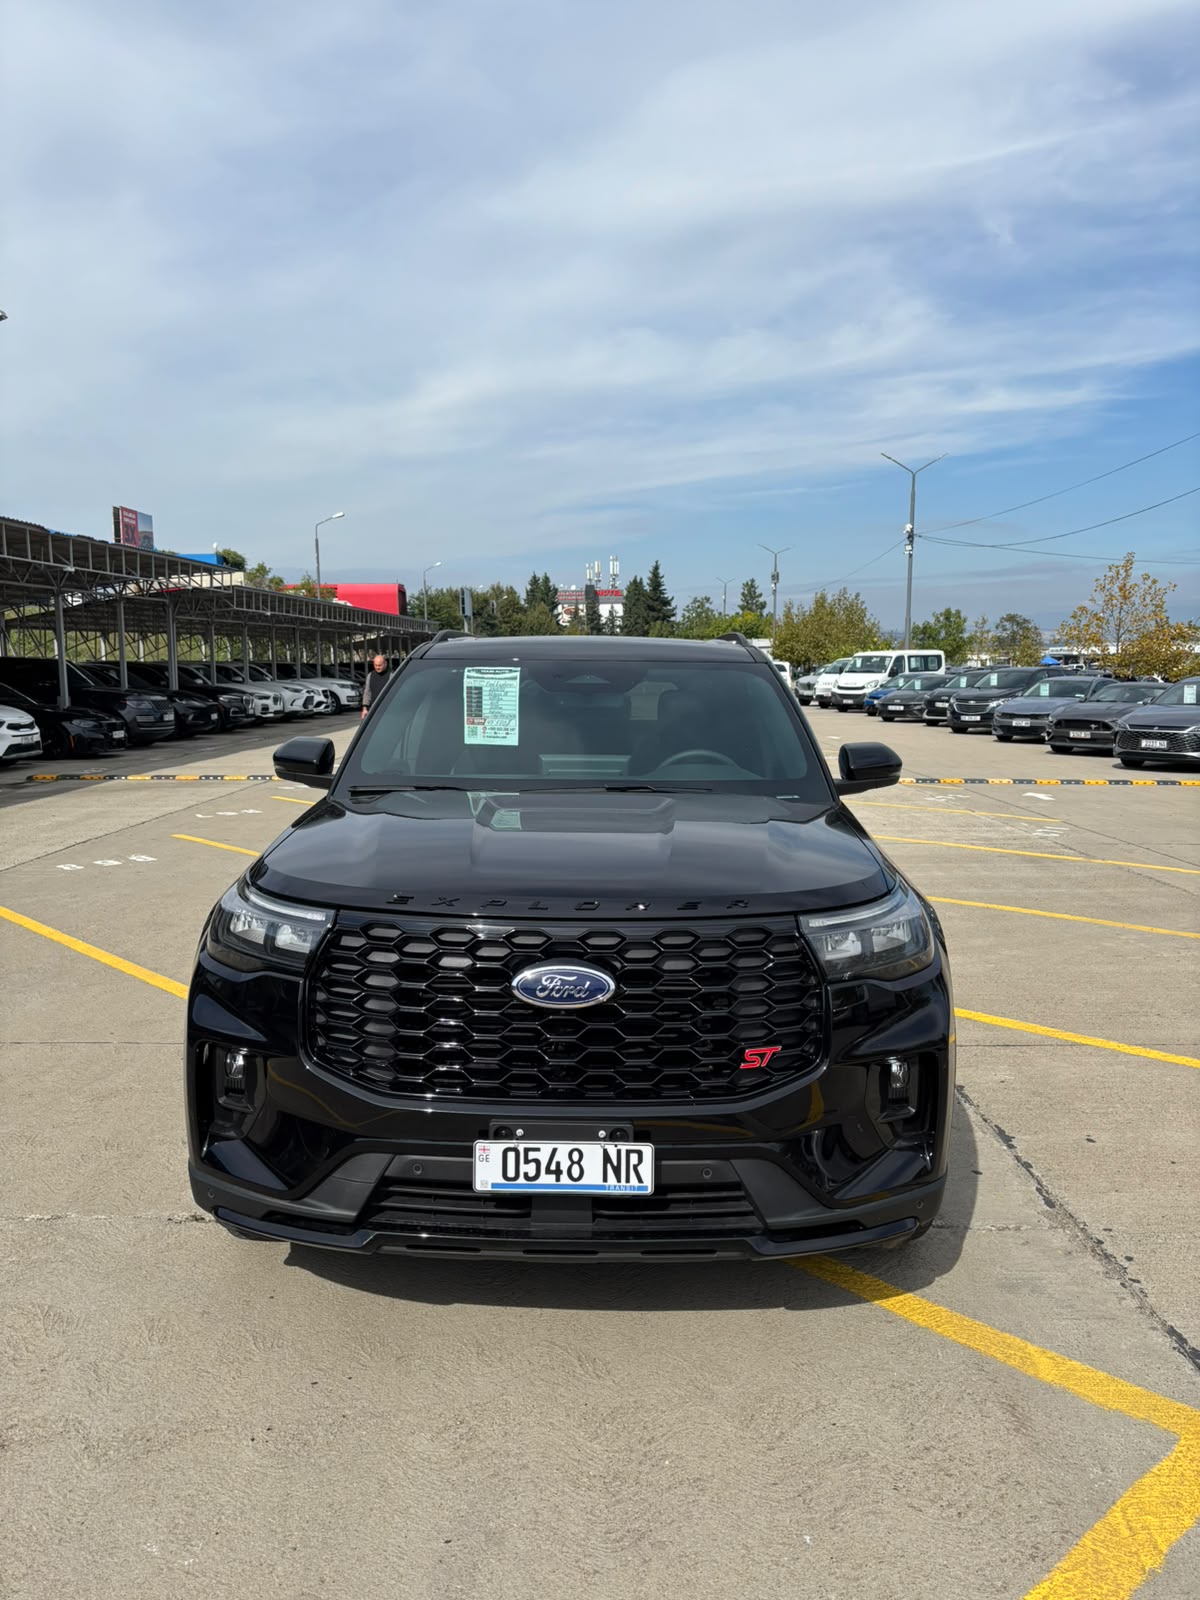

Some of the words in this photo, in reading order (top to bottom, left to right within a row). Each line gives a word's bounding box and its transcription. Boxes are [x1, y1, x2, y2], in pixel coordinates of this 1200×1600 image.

[595, 589, 623, 597] HOTEL
[387, 893, 751, 910] EXPLORER
[535, 974, 591, 998] Ford
[739, 1045, 782, 1069] ST
[478, 1154, 490, 1163] GE
[501, 1146, 585, 1183] 0548
[602, 1147, 644, 1184] NR
[605, 1184, 638, 1192] TRANSIT
